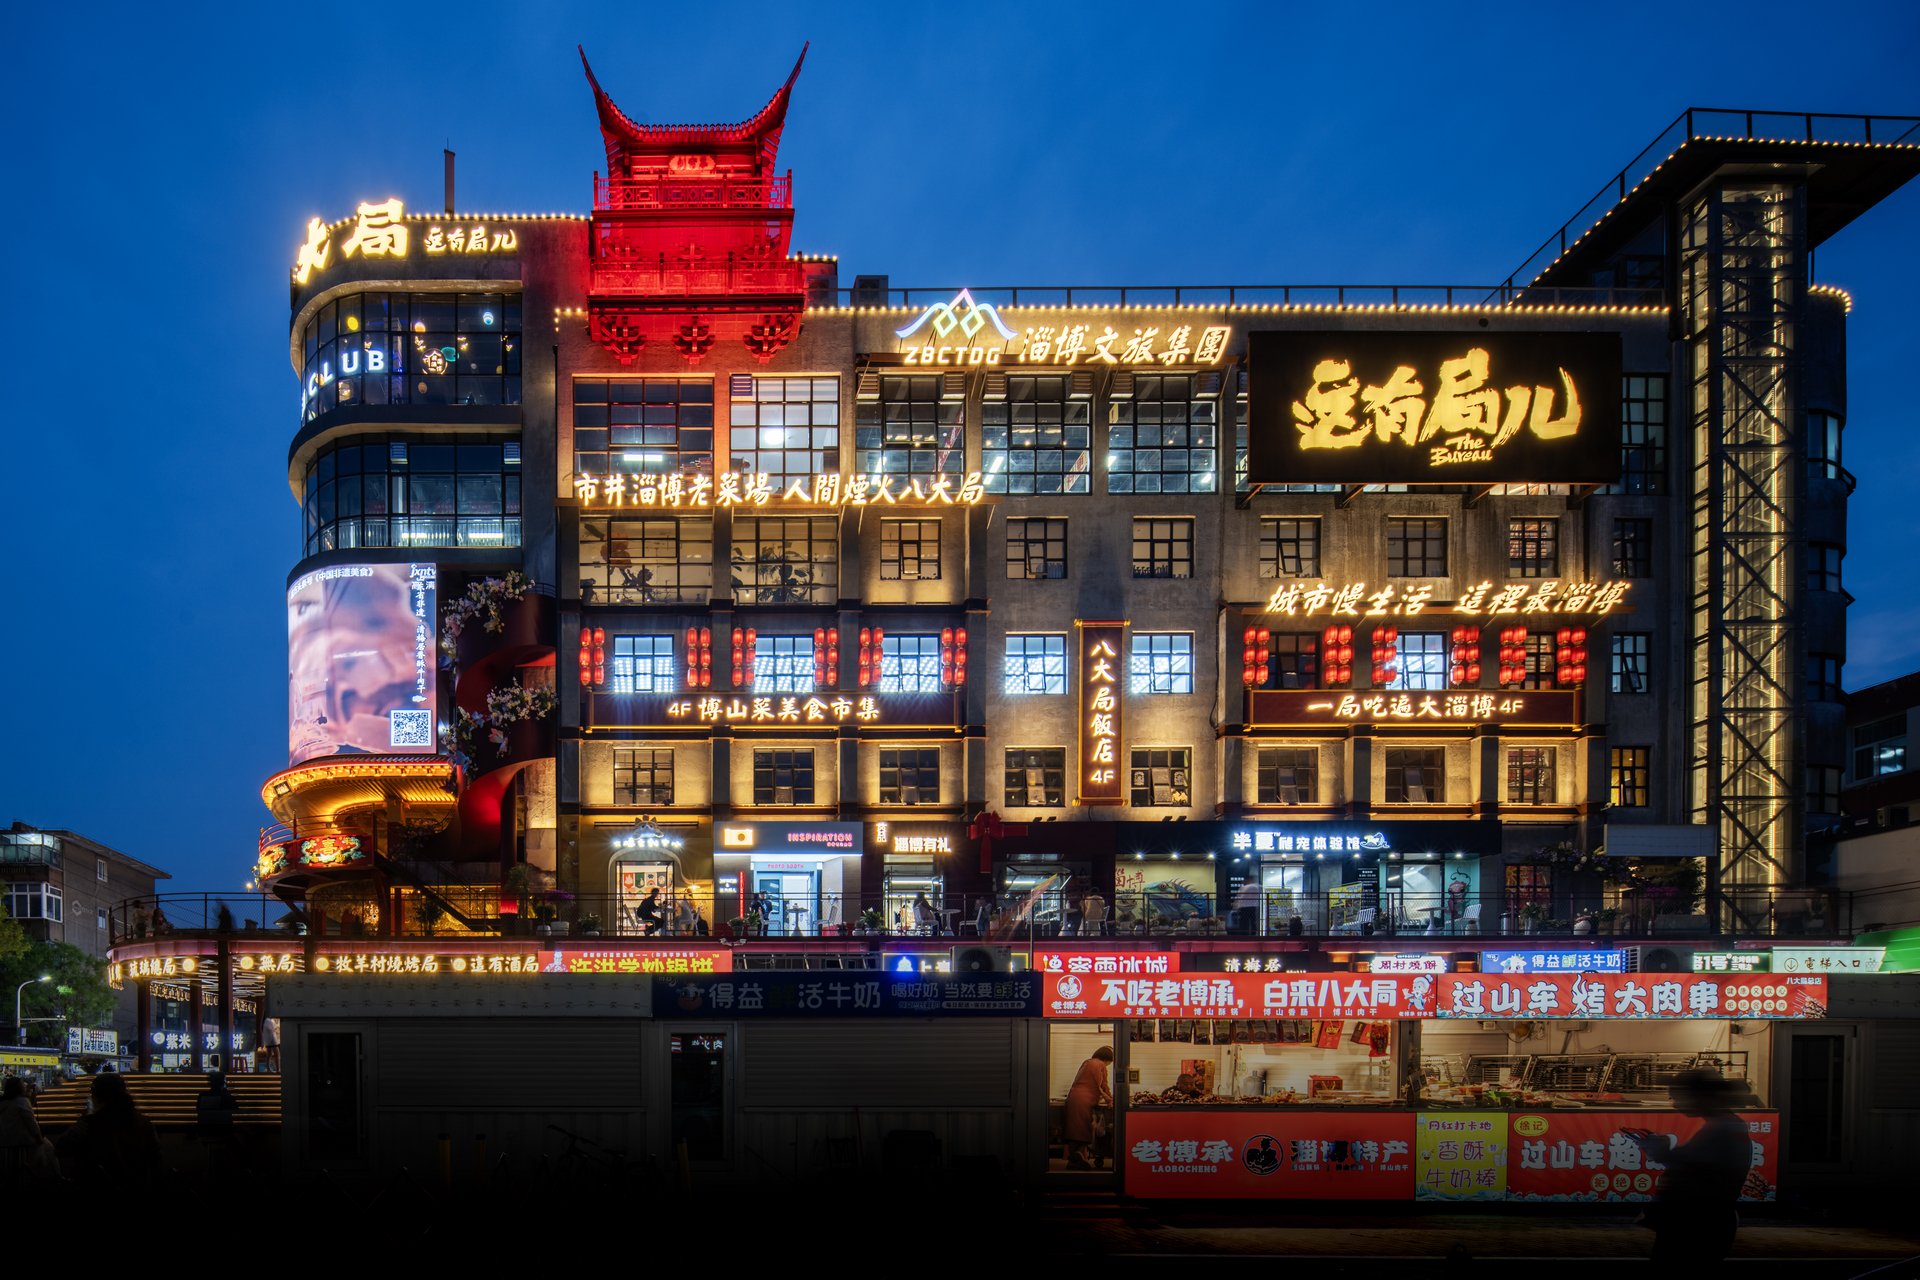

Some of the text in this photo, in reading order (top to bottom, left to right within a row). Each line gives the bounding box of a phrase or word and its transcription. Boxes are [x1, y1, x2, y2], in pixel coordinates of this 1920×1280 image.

[903, 346, 1001, 365] ZBCTDG
[1019, 325, 1232, 366] 淄博文旅集團
[308, 350, 386, 397] CLUB
[1446, 433, 1485, 449] The
[1430, 446, 1493, 466] Bureau
[574, 472, 986, 507] 市井淄博老菜場 人間煙火八大局
[1266, 581, 1631, 617] 城市慢生活 這裡最淄博
[668, 697, 880, 720] 4F 博山菜美食市集
[1091, 640, 1117, 763] 八大局飯店
[1307, 695, 1523, 719] 一局吃遍大淄博 4F
[1091, 770, 1115, 784] 4F
[788, 833, 853, 842] INSPIRATION
[895, 837, 952, 853] 淄博有礼
[335, 955, 439, 974] 牧羊村燒烤局
[1224, 957, 1281, 972] 清梅居
[1532, 954, 1621, 968] 得益鲜活牛奶
[1804, 957, 1861, 969] 電梯入口
[1264, 979, 1398, 1007] 白来八大局
[1452, 974, 1719, 1015] 过山车烤大肉串
[1428, 1119, 1492, 1131] 网红打卡地
[1519, 1119, 1544, 1131] 徐记
[1131, 1139, 1234, 1163] 老博承
[1438, 1140, 1485, 1160] 香酥
[1152, 1165, 1218, 1173] LAOBOCHENG
[1426, 1168, 1496, 1189] 牛奶棒
